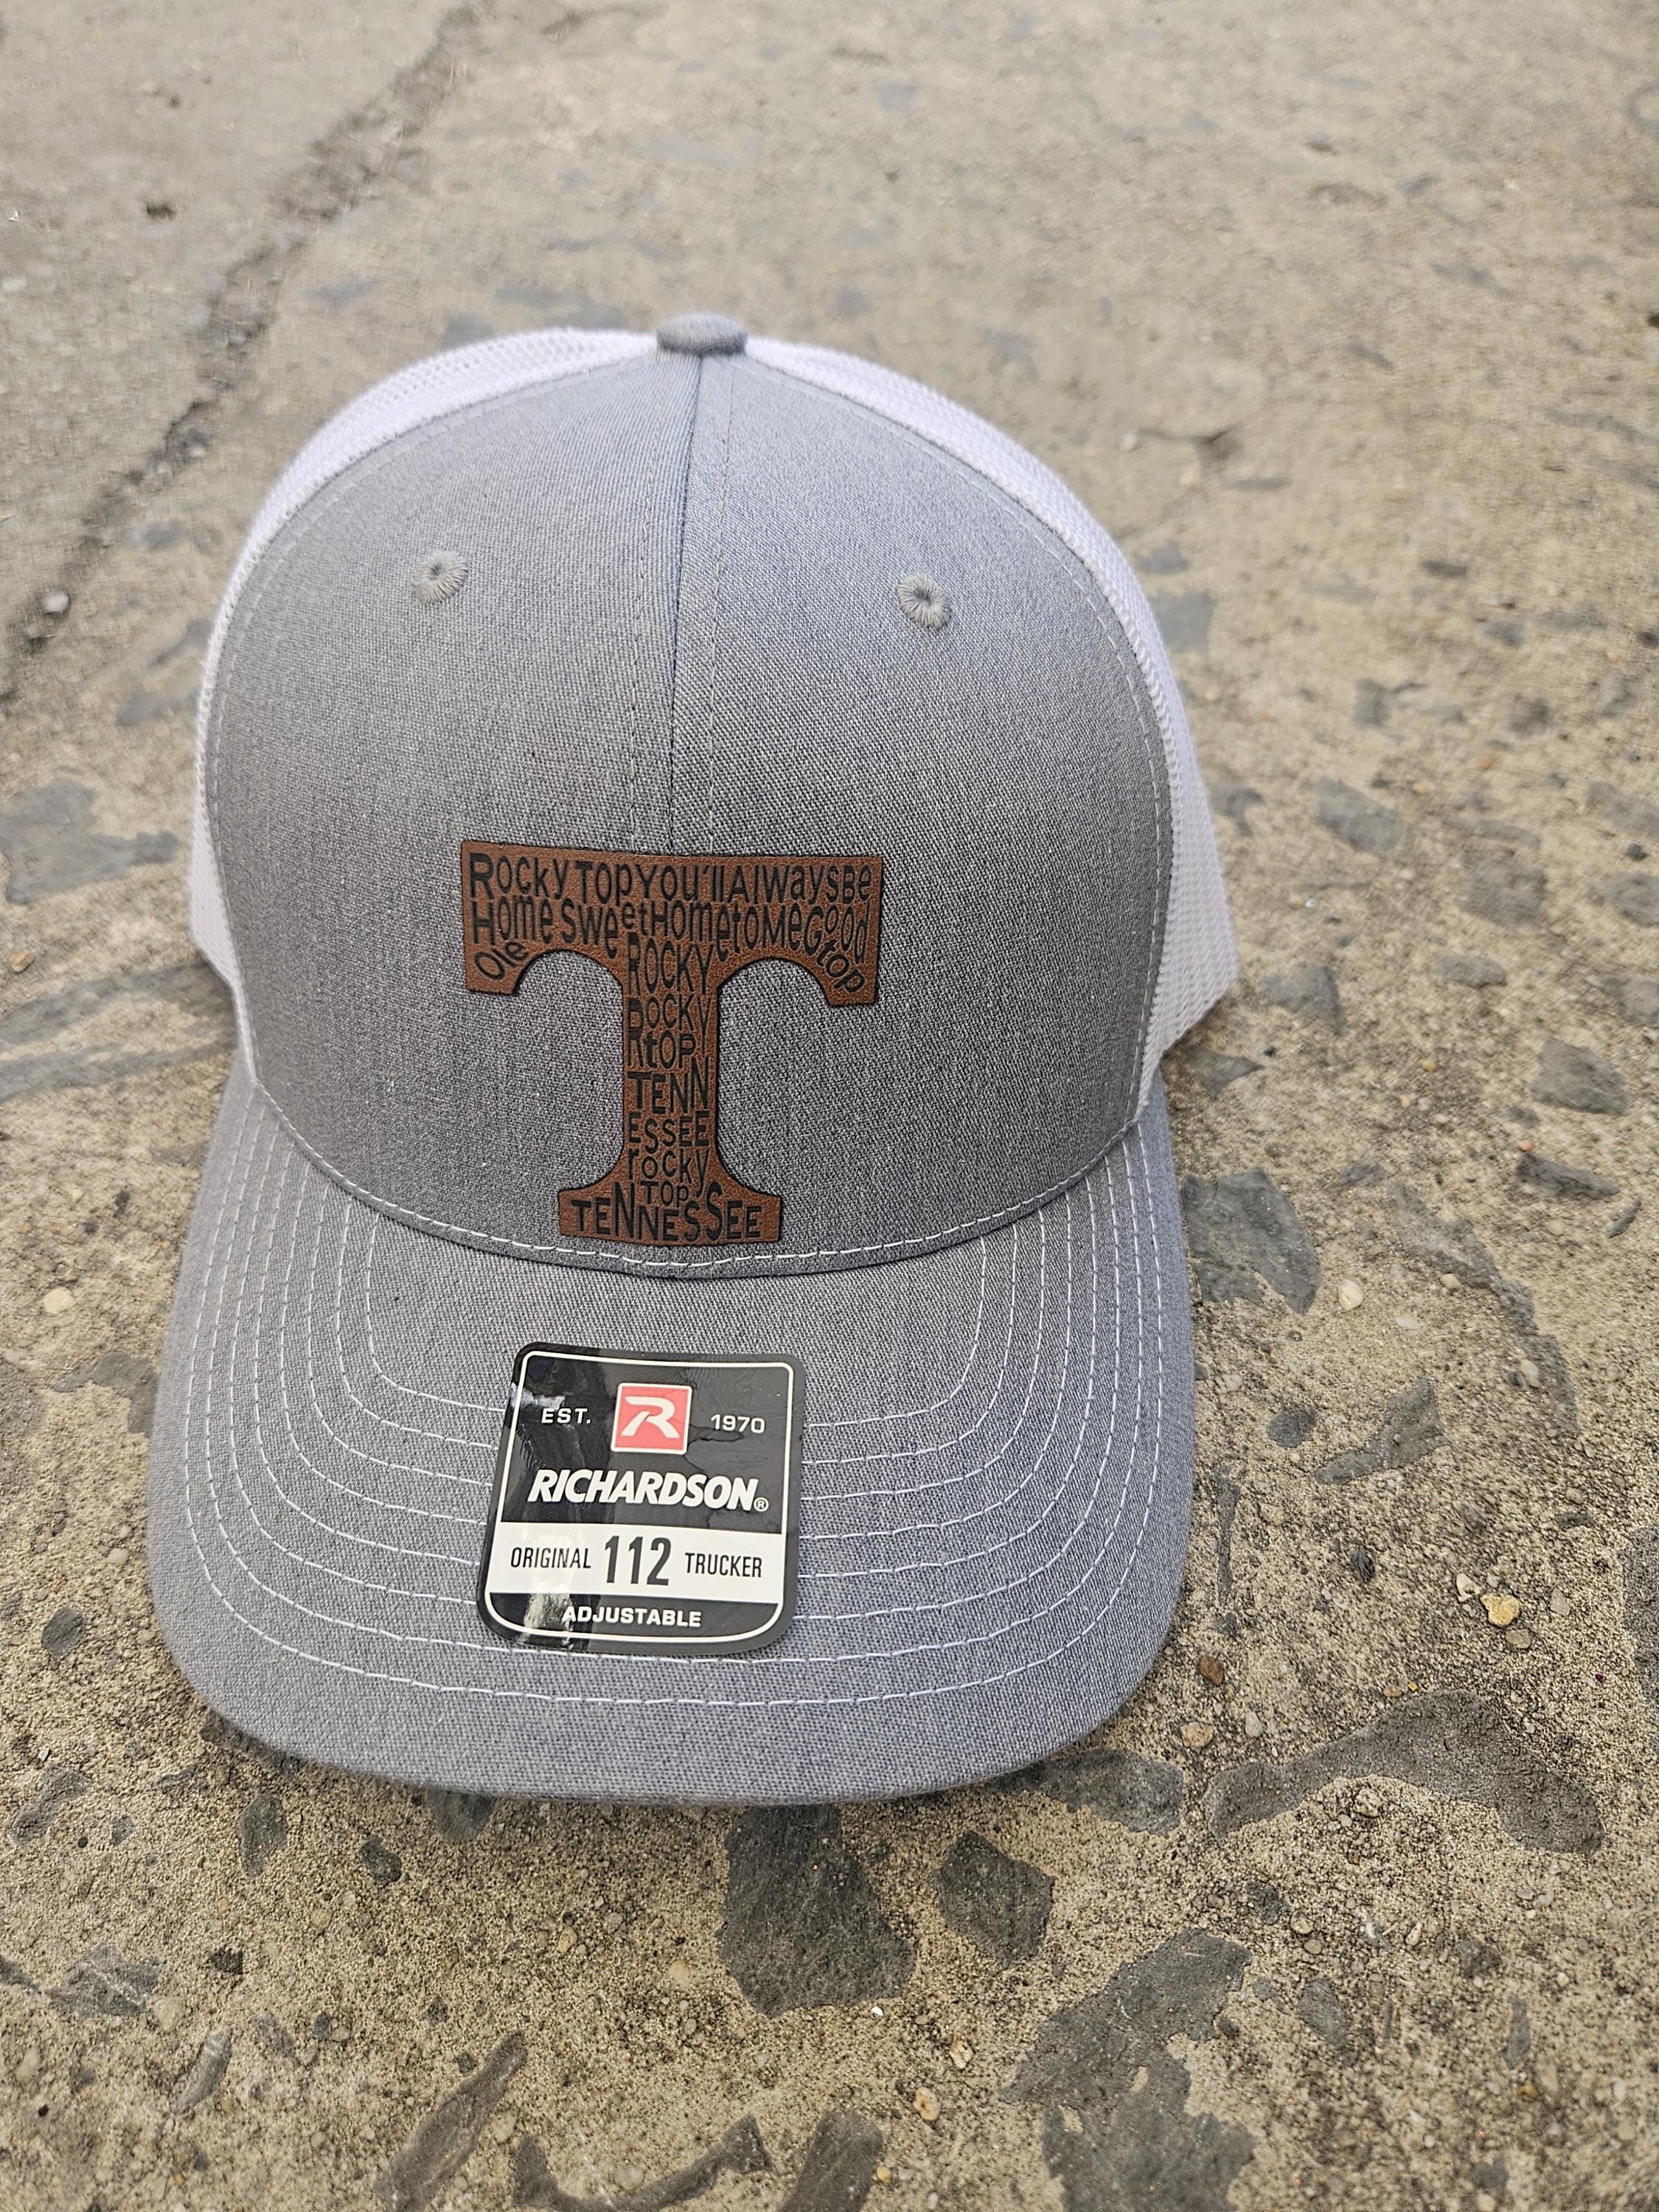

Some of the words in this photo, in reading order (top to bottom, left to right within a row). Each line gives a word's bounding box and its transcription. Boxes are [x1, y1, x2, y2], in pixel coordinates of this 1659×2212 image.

[541, 1407, 592, 1425] EST.
[710, 1413, 765, 1434] 1970
[510, 1546, 591, 1569] ORIGINAL
[605, 1534, 672, 1587] 112
[685, 1551, 762, 1579] TRUCKER
[561, 1604, 703, 1628] ADJUSTABLE
